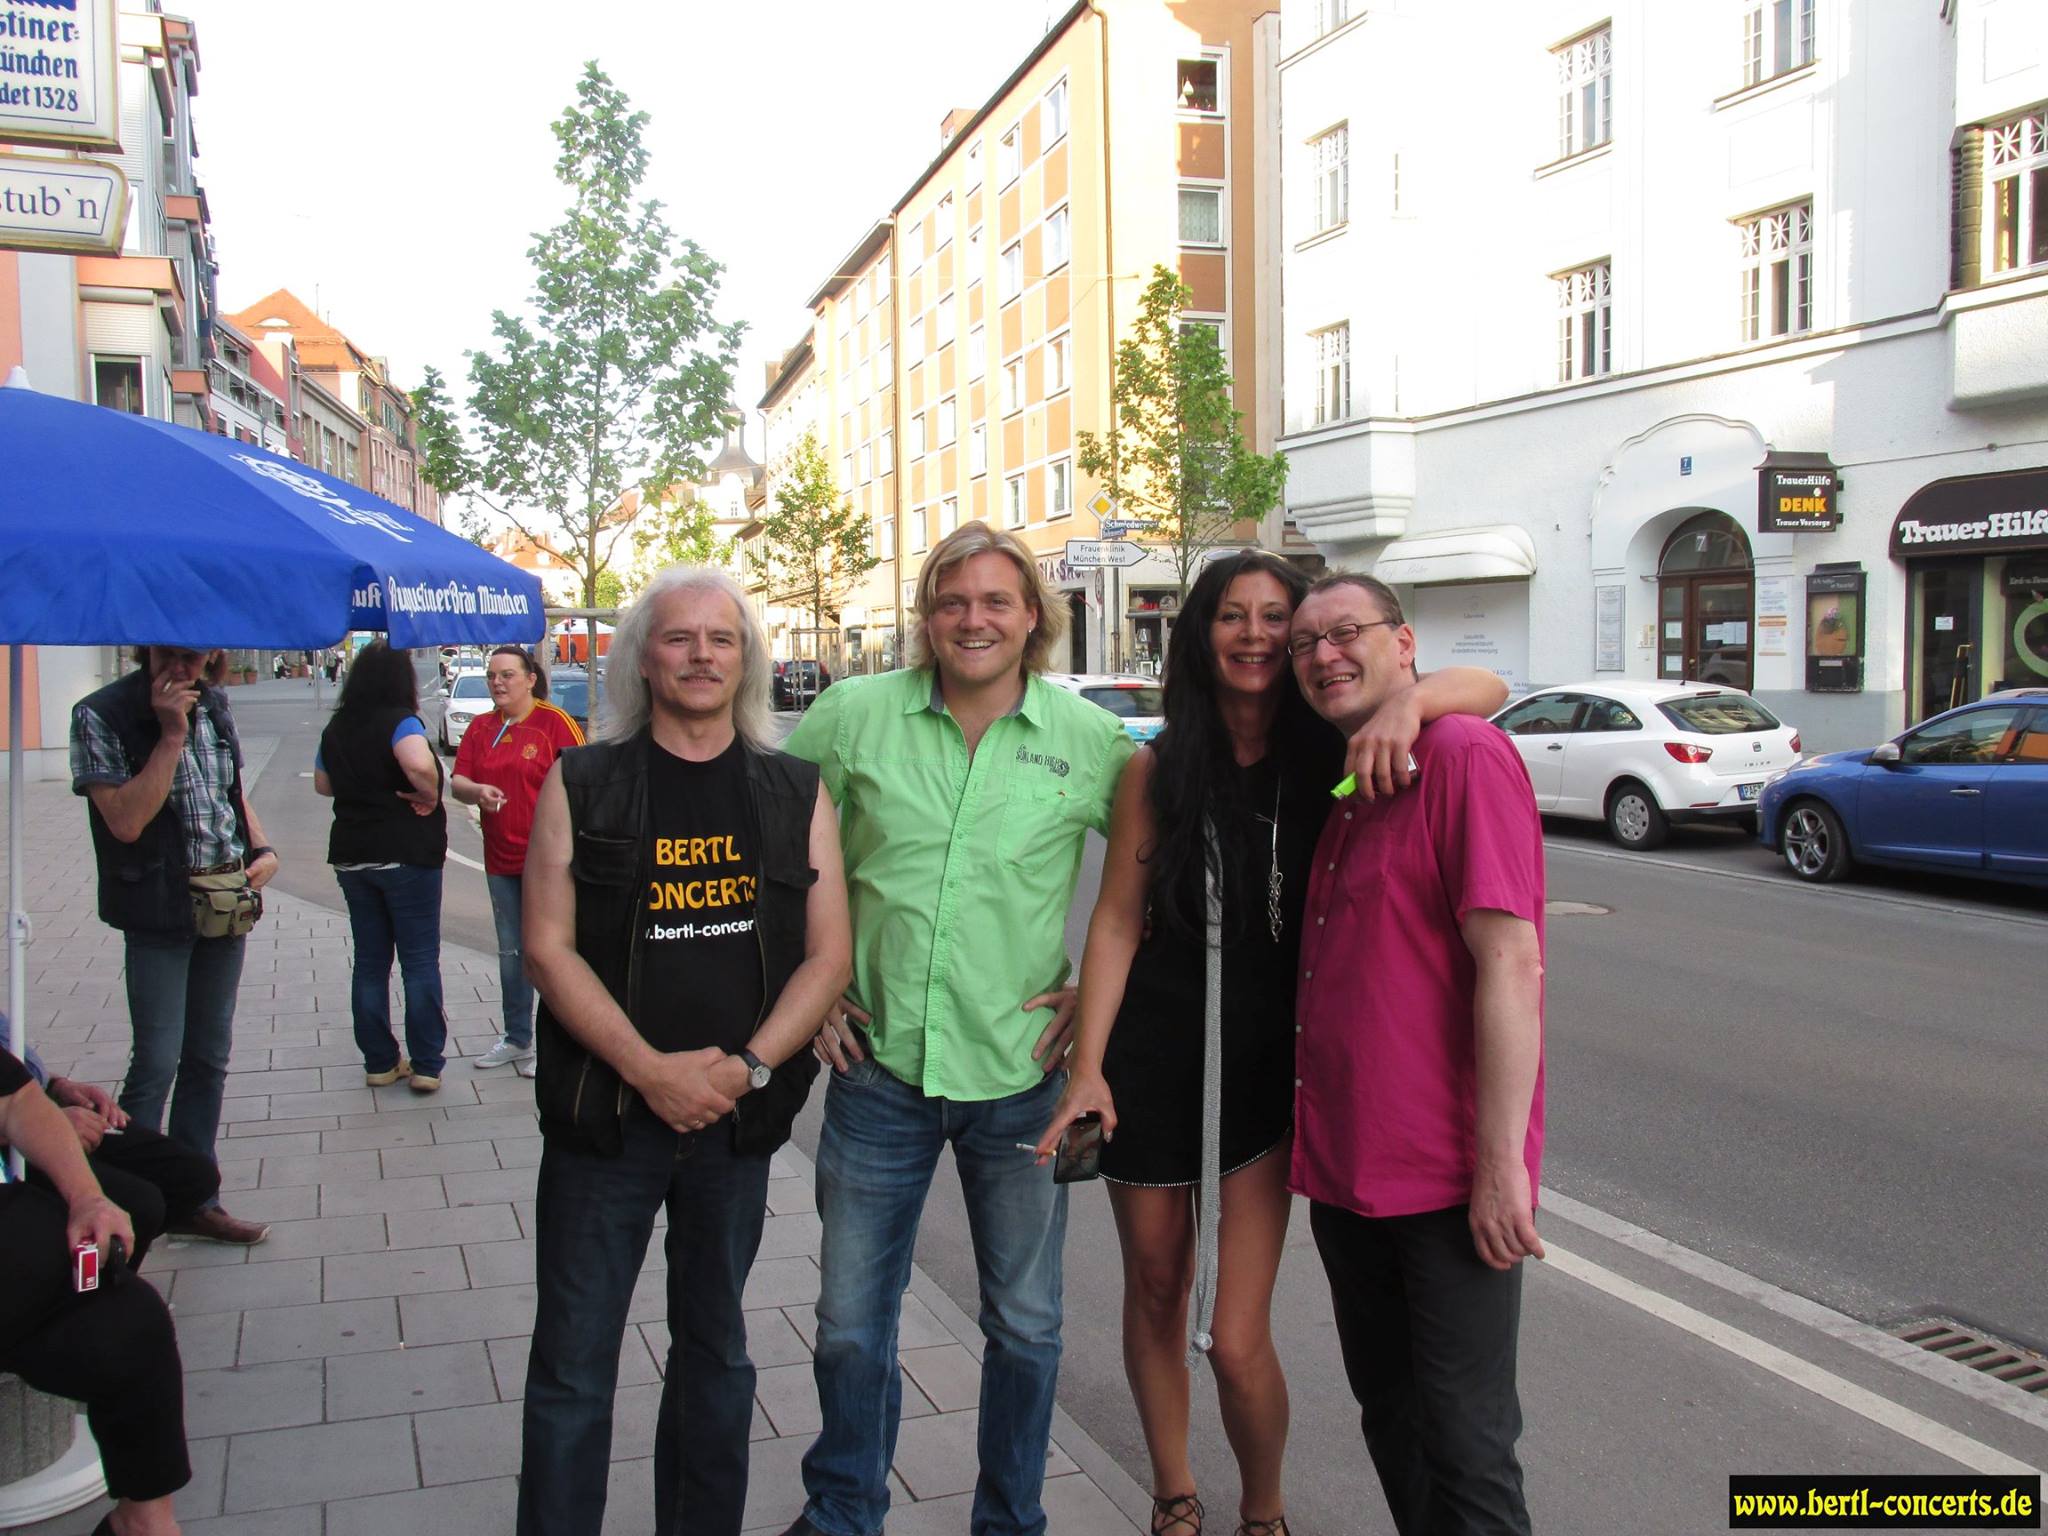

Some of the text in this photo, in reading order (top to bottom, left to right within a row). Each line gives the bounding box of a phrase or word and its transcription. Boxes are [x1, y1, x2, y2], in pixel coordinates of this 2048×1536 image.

[34, 86, 78, 112] 1328
[1780, 497, 1827, 512] DENK
[1080, 544, 1126, 552] Frauenklinik
[1696, 535, 1706, 551] 7
[1073, 554, 1126, 563] München West
[477, 585, 529, 616] München
[656, 835, 741, 866] BERTL
[646, 919, 754, 940] .bertl-concer
